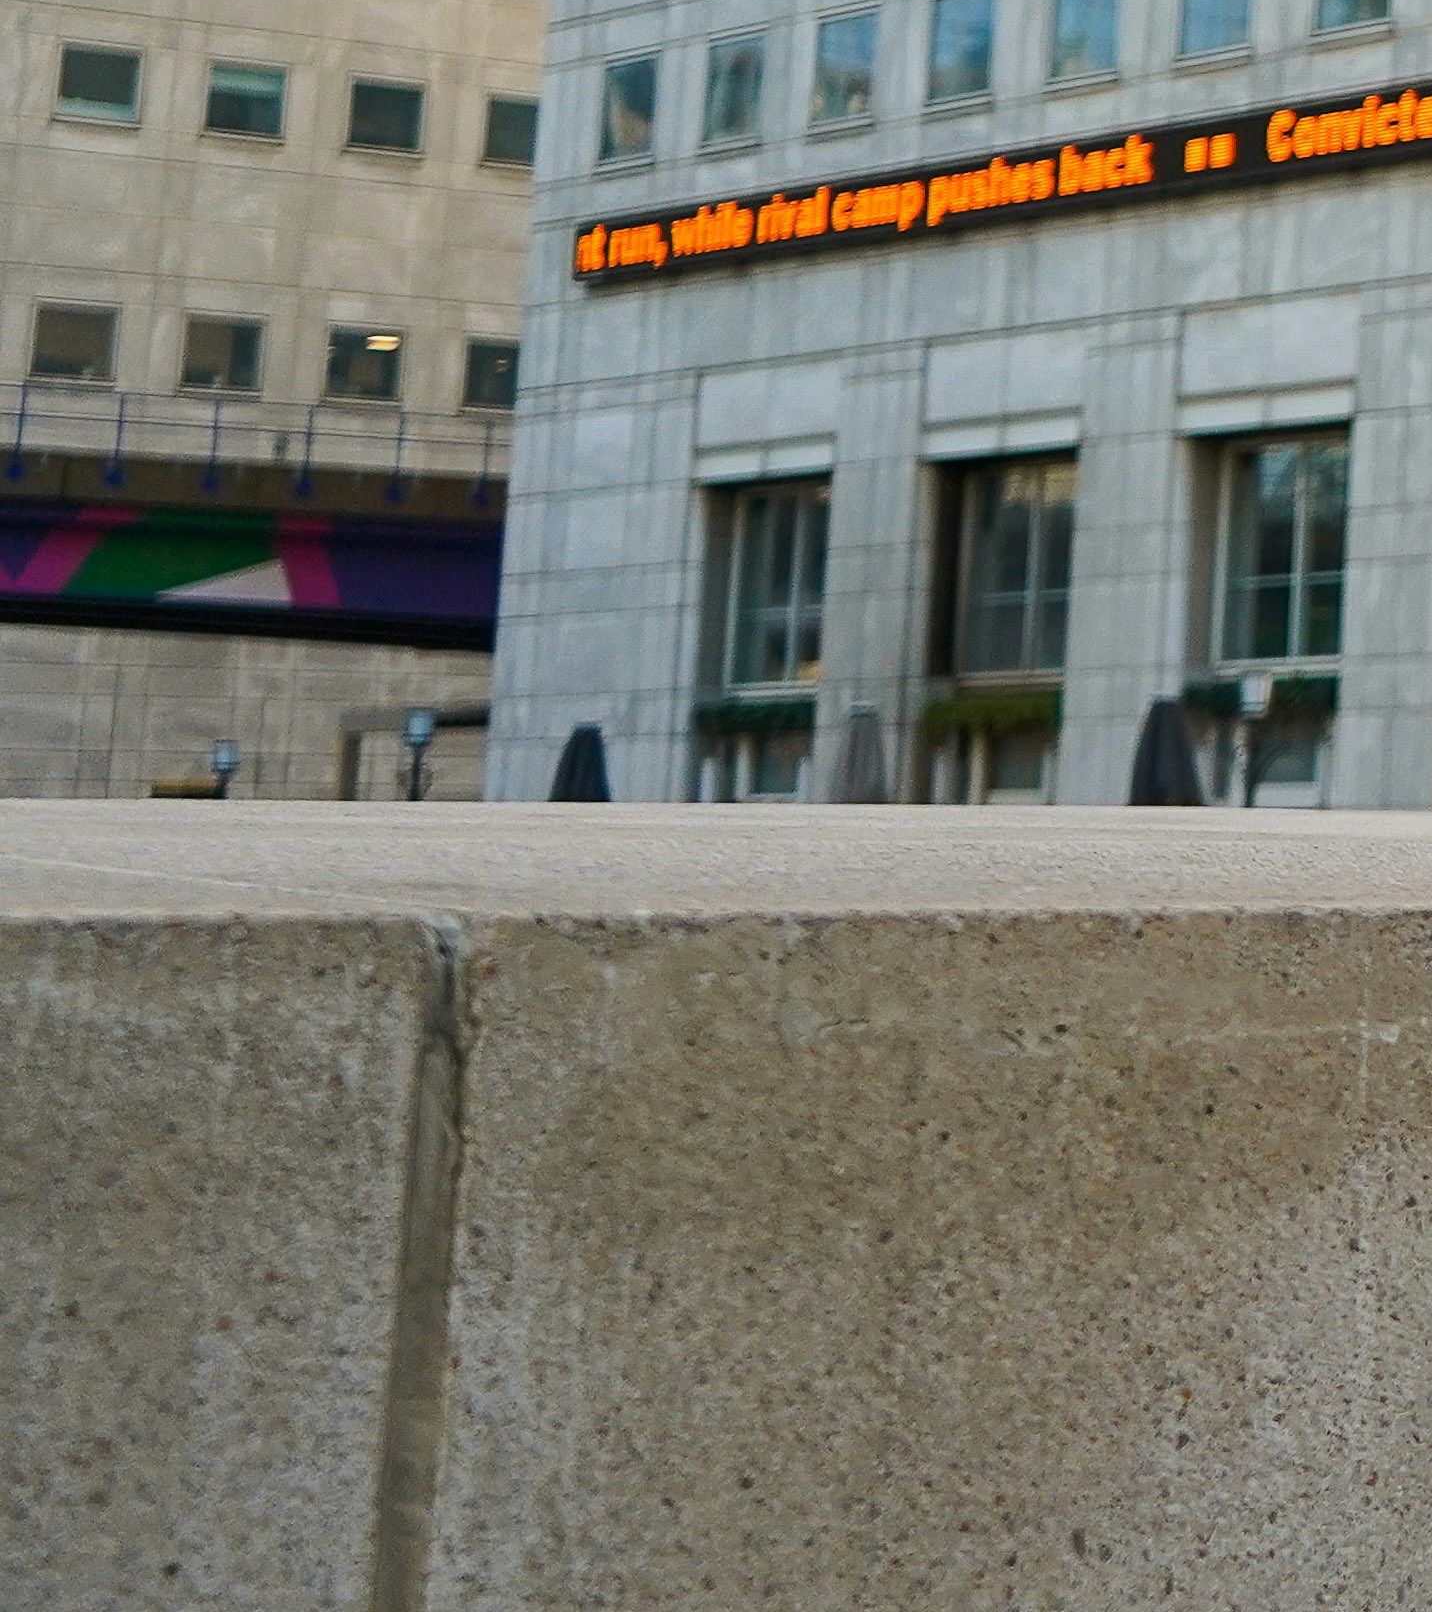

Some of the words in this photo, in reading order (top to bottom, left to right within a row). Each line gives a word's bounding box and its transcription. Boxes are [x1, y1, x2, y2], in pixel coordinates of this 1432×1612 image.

[608, 223, 669, 270] run,
[670, 200, 755, 258] while
[756, 185, 830, 244] rival
[831, 180, 926, 232] camp
[926, 157, 1056, 227] pushes
[1058, 134, 1154, 197] back
